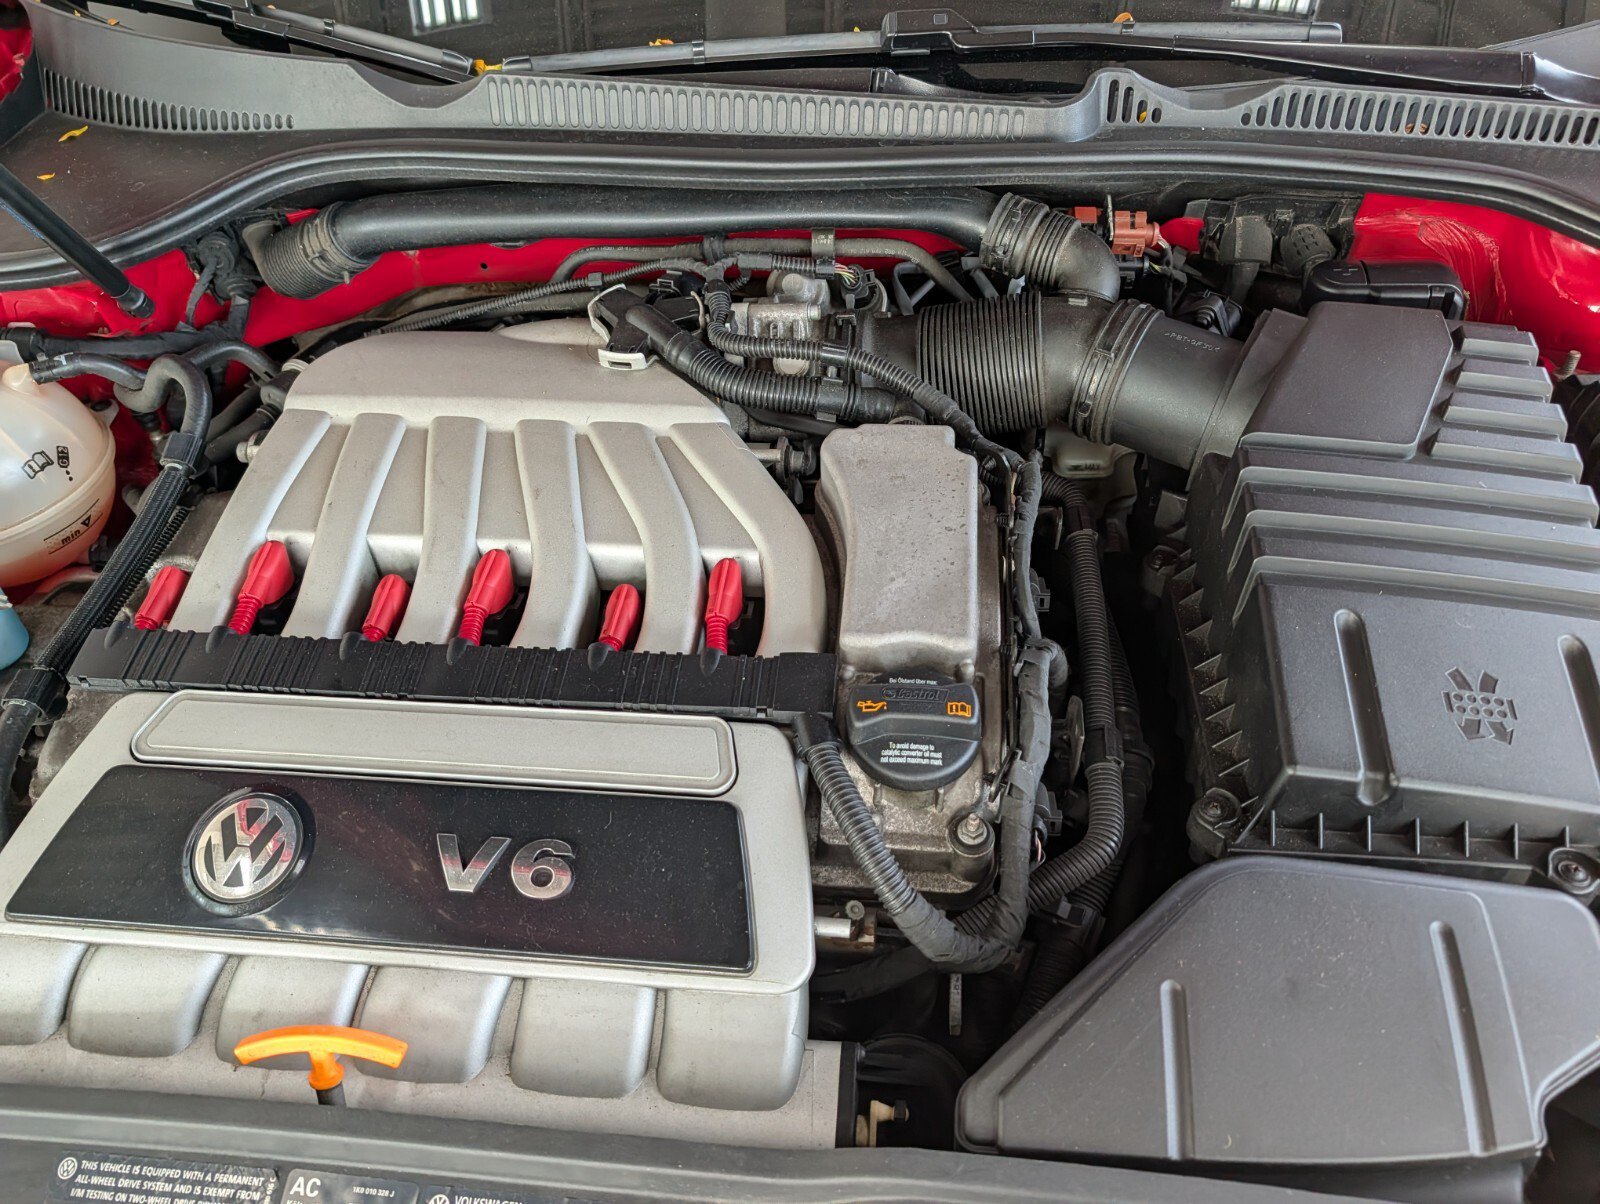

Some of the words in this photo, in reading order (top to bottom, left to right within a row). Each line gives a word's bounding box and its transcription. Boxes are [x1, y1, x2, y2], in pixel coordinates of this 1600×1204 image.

[61, 529, 80, 545] min
[897, 688, 940, 700] Castrol
[910, 743, 929, 751] damage
[436, 832, 576, 900] V6
[81, 1160, 99, 1170] THIS
[100, 1162, 131, 1174] VEHICLE
[132, 1165, 141, 1174] IS
[142, 1166, 181, 1178] EQUIPPED
[183, 1170, 204, 1180] WITH
[205, 1173, 212, 1181] A
[214, 1174, 265, 1186] PERMANENT
[70, 1188, 84, 1198] I/M
[85, 1189, 114, 1200] TESTING
[115, 1192, 128, 1202] ON
[74, 1174, 116, 1187] ALL-WHEEL
[118, 1178, 141, 1189] DRIVE
[142, 1180, 172, 1192] SYSTEM
[173, 1184, 192, 1194] AND
[193, 1186, 201, 1195] IS
[202, 1186, 236, 1198] EXEMPT
[236, 1190, 261, 1201] FROM
[289, 1176, 321, 1198] AC
